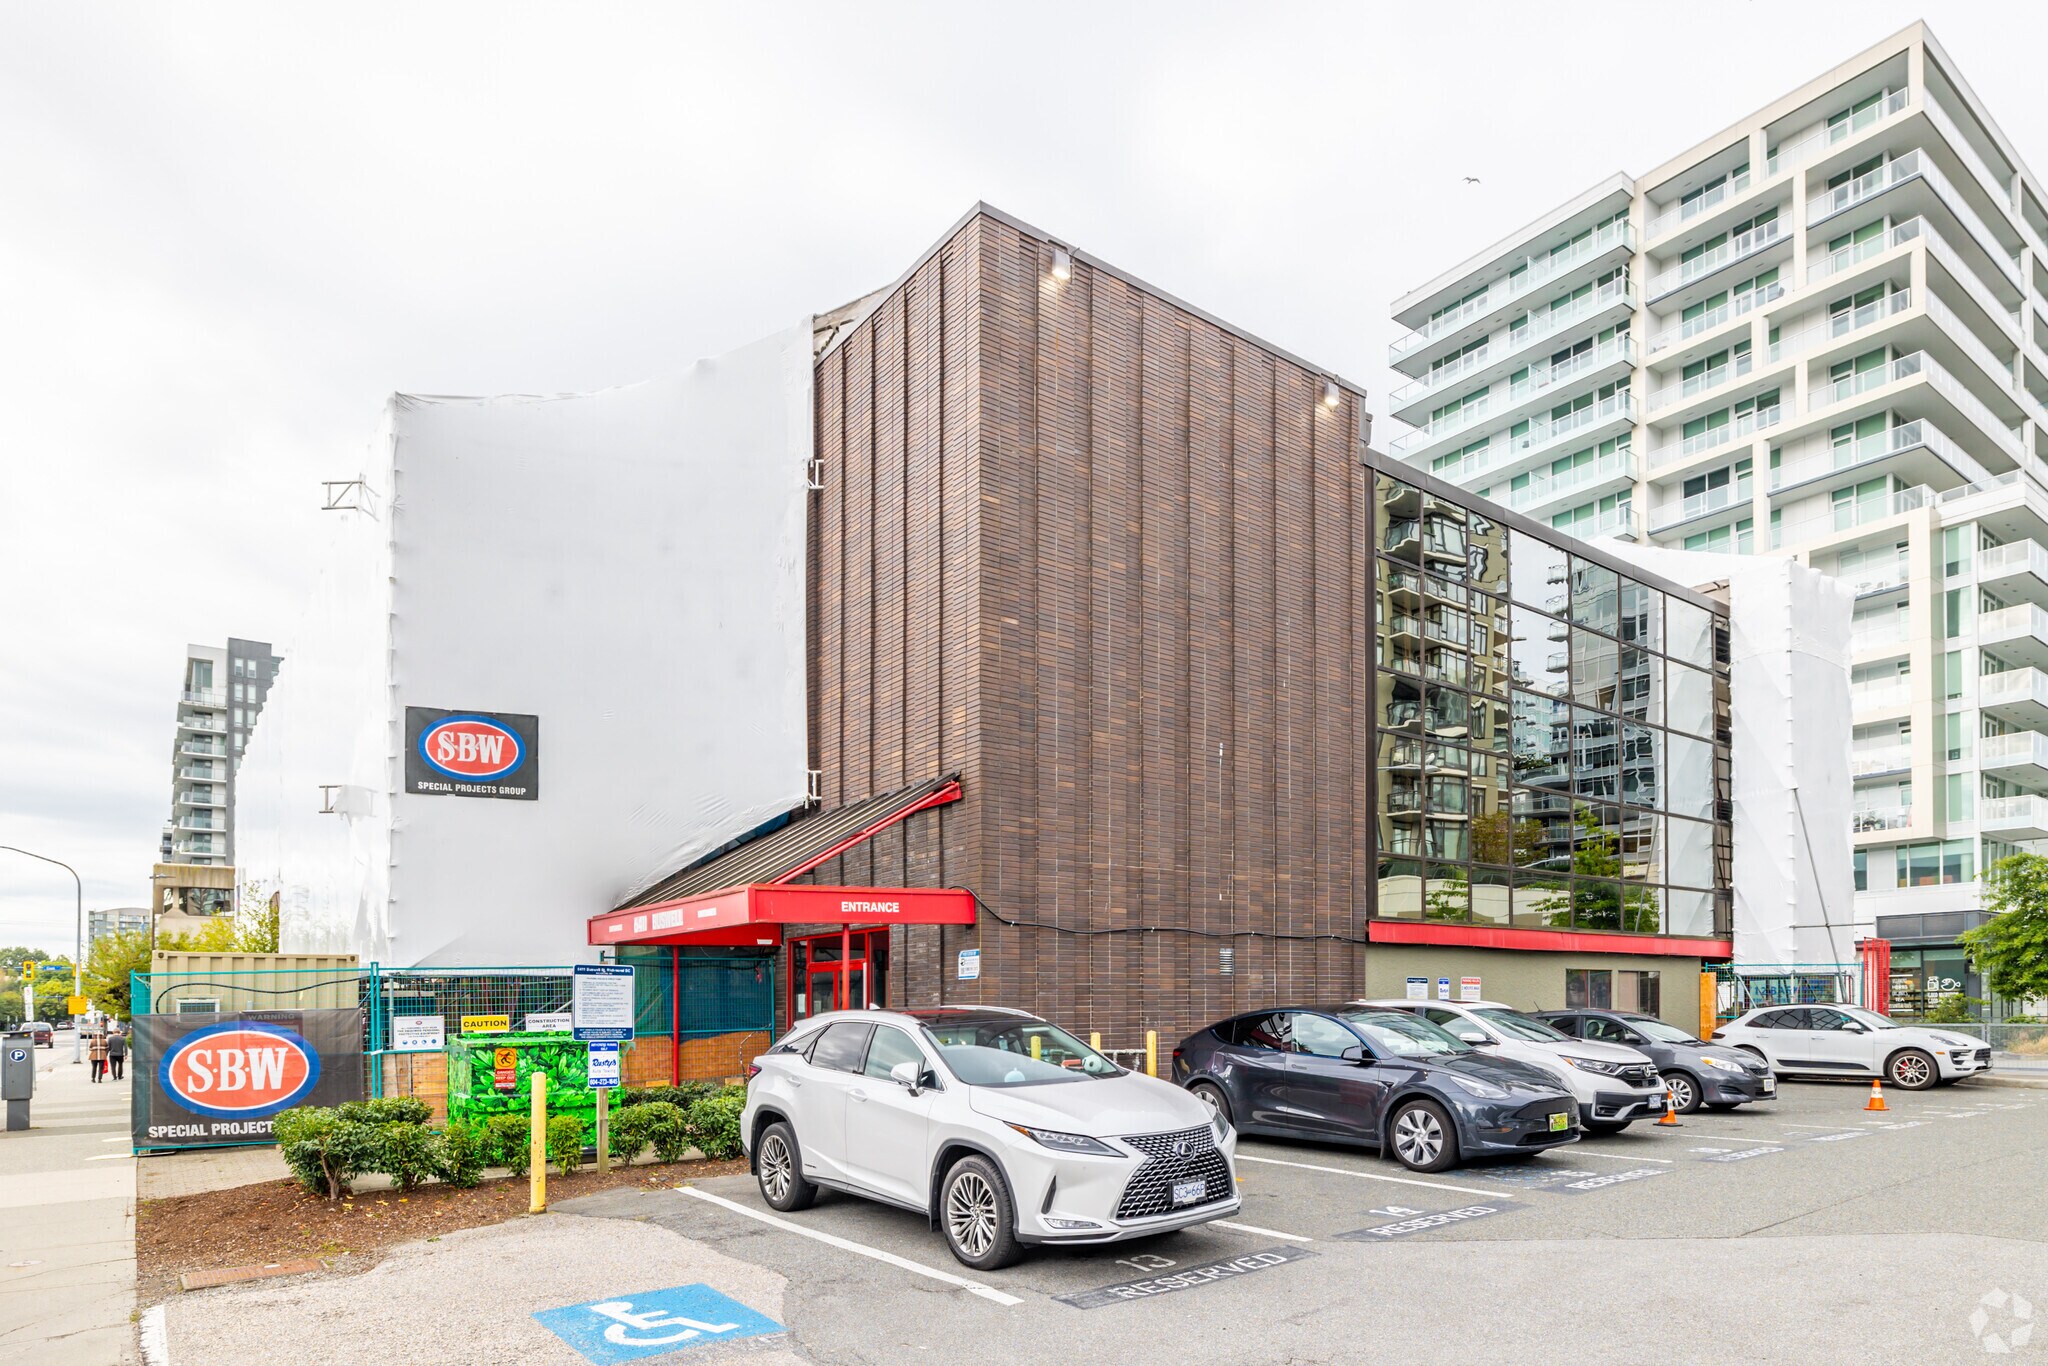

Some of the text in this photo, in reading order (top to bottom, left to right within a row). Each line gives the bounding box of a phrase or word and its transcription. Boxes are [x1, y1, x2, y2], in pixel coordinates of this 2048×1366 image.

[417, 780, 527, 796] SPECIAL PROJECTS GROUP
[841, 901, 900, 913] ENTRANCE
[463, 1019, 508, 1028] CAUTION
[149, 1121, 275, 1139] SPECIAL PROJECT
[1366, 1205, 1498, 1237] RESERVED
[1115, 1254, 1176, 1273] 13
[1106, 1252, 1288, 1299] RESERVED
